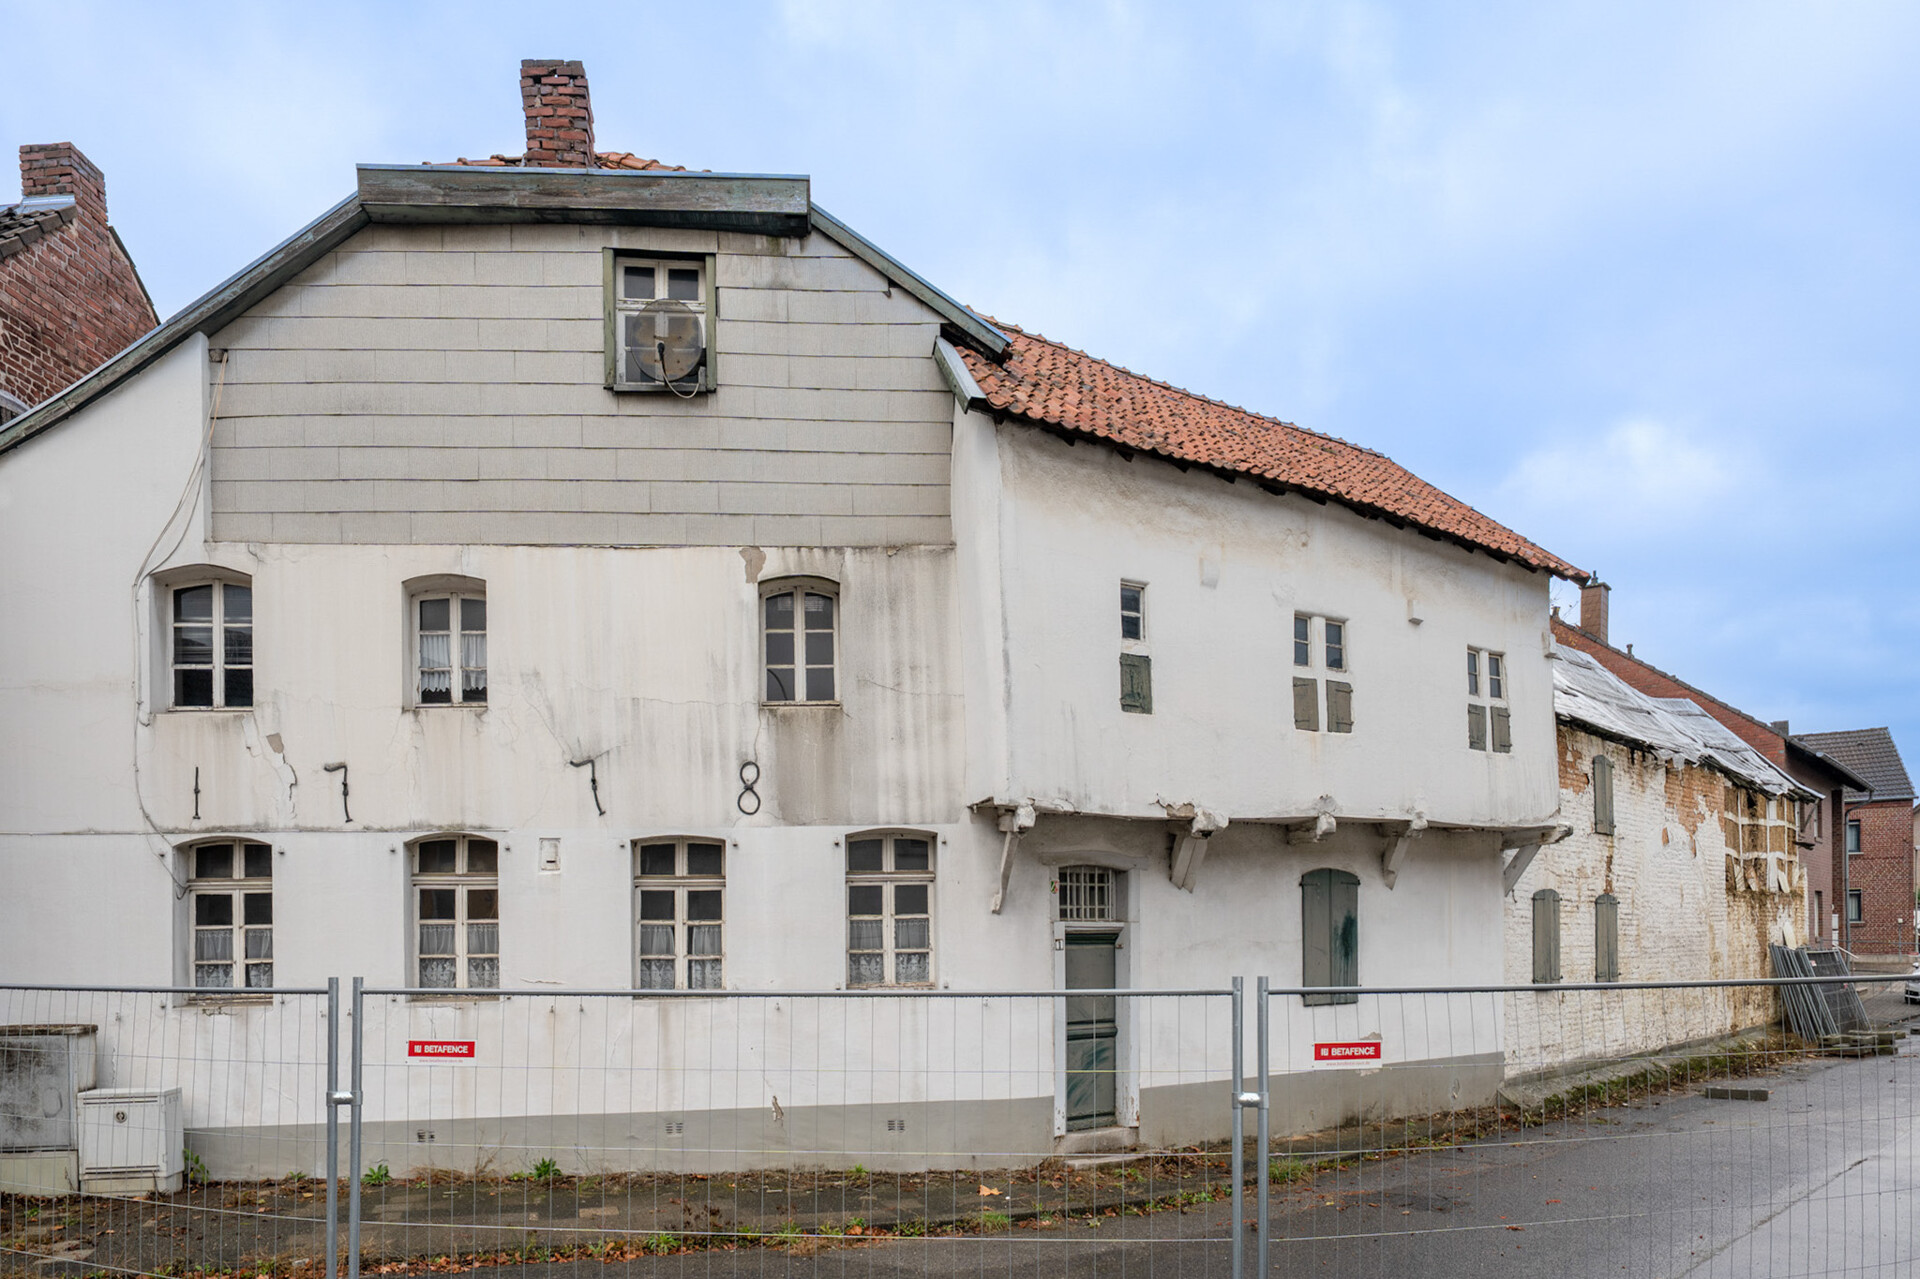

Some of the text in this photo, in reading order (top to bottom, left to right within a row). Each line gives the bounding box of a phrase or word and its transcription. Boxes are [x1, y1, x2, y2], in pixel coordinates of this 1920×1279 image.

[737, 761, 761, 815] 8
[424, 1045, 469, 1053] BETAFENCE
[1331, 1046, 1376, 1056] BETAFENCE
